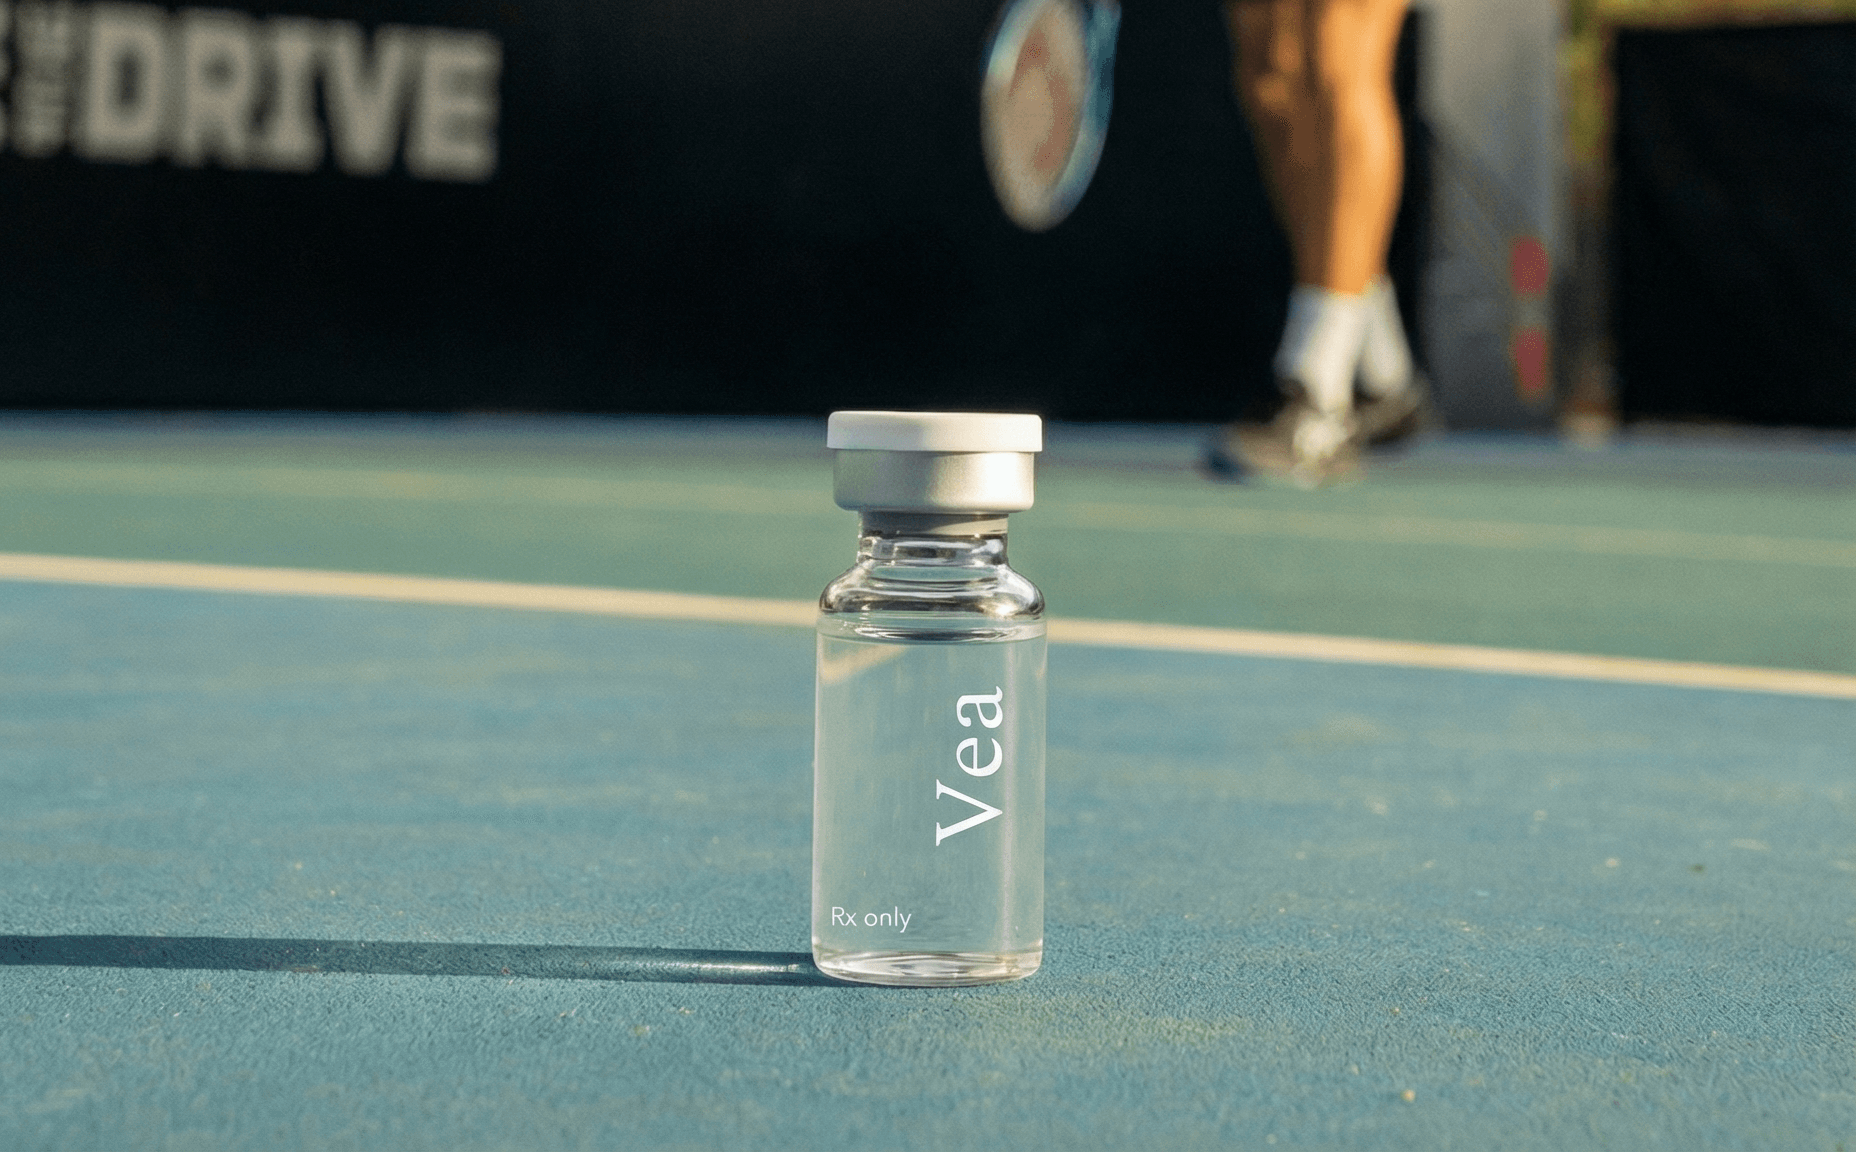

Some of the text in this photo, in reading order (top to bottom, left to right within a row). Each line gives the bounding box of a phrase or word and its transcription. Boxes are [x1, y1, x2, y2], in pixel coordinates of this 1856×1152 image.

[78, 1, 499, 179] DRIVE
[936, 685, 1003, 846] Vea
[831, 905, 912, 934] Rx only
